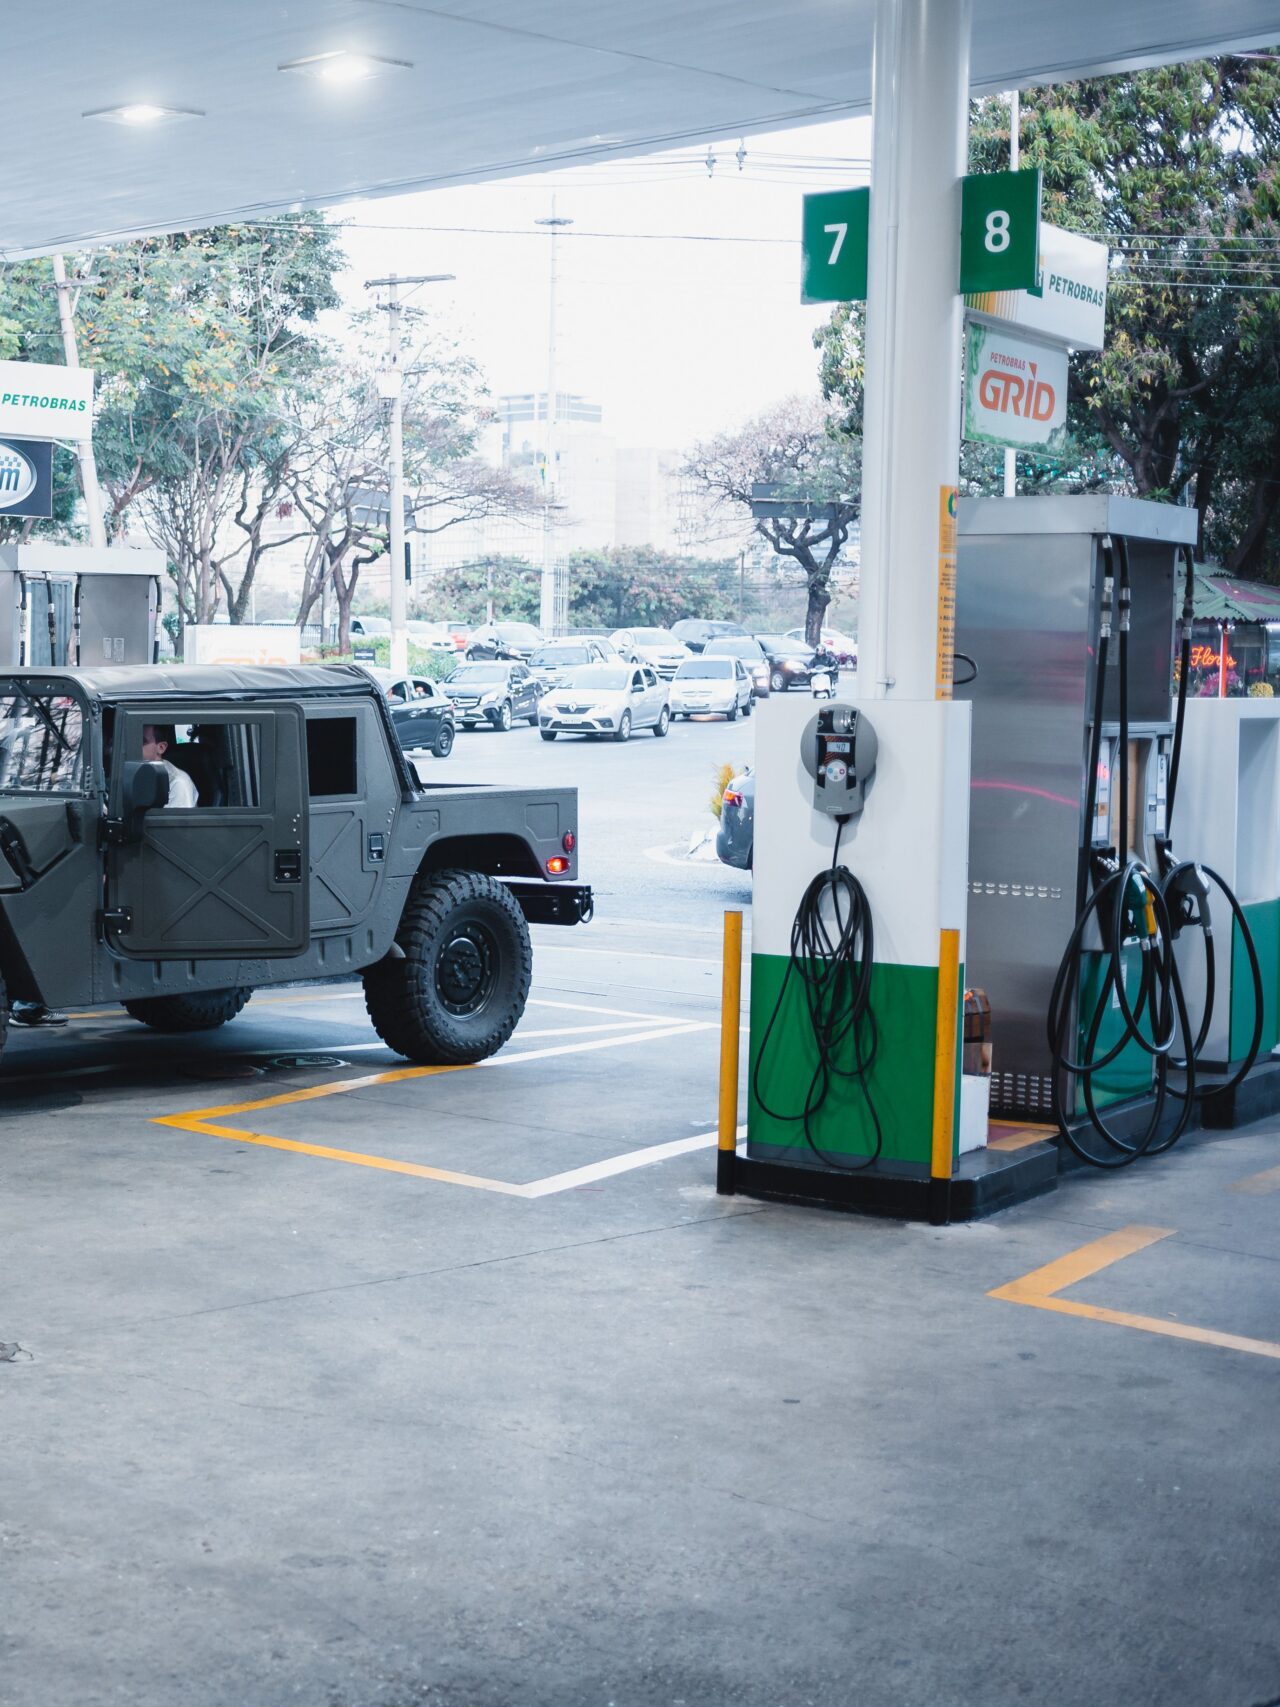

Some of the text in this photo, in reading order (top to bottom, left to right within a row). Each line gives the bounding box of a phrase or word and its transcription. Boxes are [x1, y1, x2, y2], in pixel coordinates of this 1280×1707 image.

[824, 223, 848, 265] 7
[984, 210, 1011, 253] 8
[1048, 273, 1104, 308] PETROBRAS
[990, 351, 1026, 372] PETROBRAS
[1, 393, 86, 412] PETROBRAS
[979, 361, 1056, 422] GRID
[1190, 646, 1237, 667] Flors
